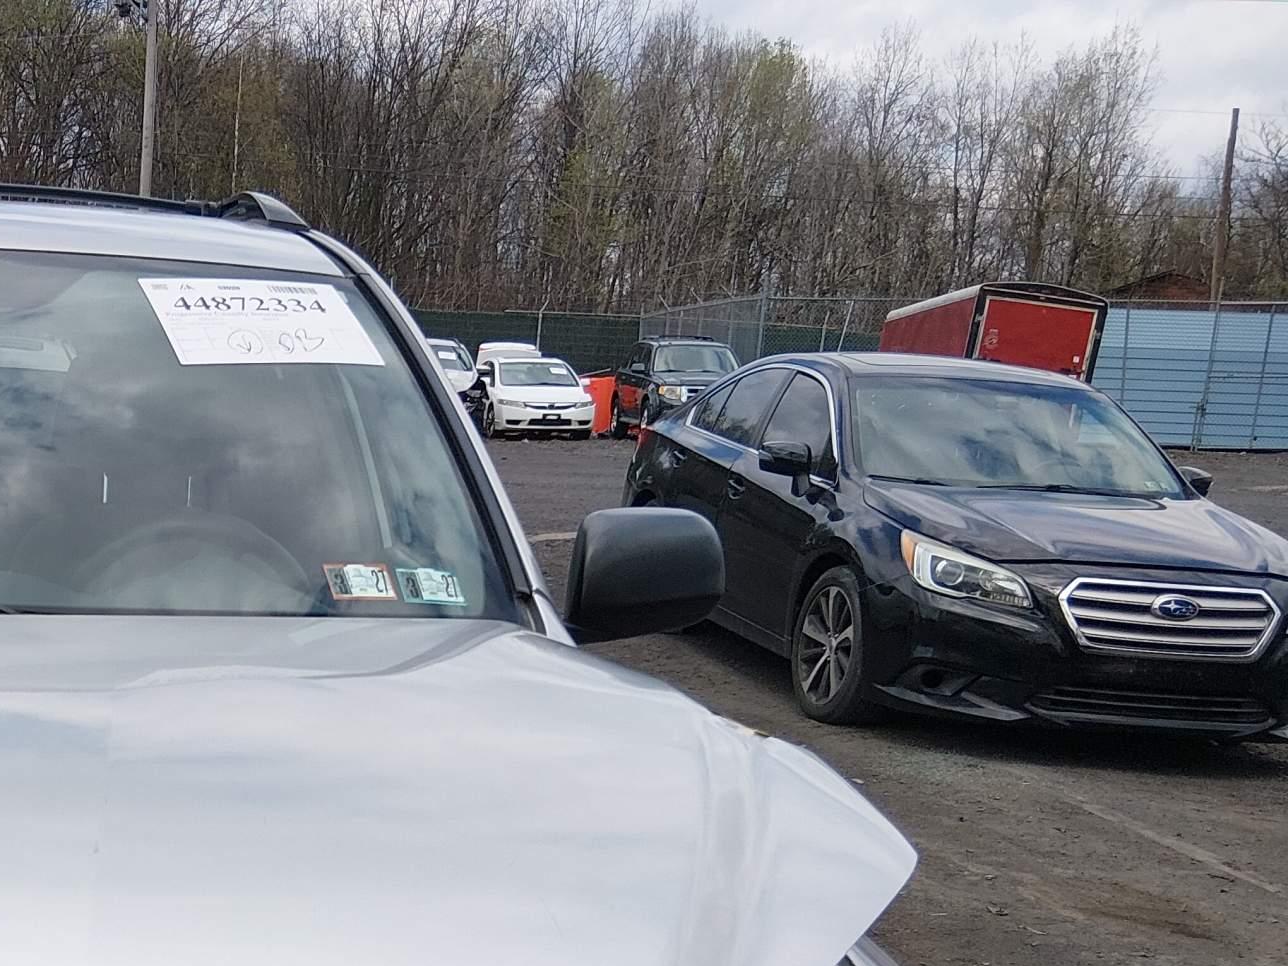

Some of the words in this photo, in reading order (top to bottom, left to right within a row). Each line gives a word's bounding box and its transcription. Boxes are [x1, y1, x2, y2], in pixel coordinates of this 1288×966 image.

[173, 295, 327, 314] 44872334
[370, 569, 389, 596] 27
[405, 576, 420, 599] 3
[440, 574, 459, 599] 27
